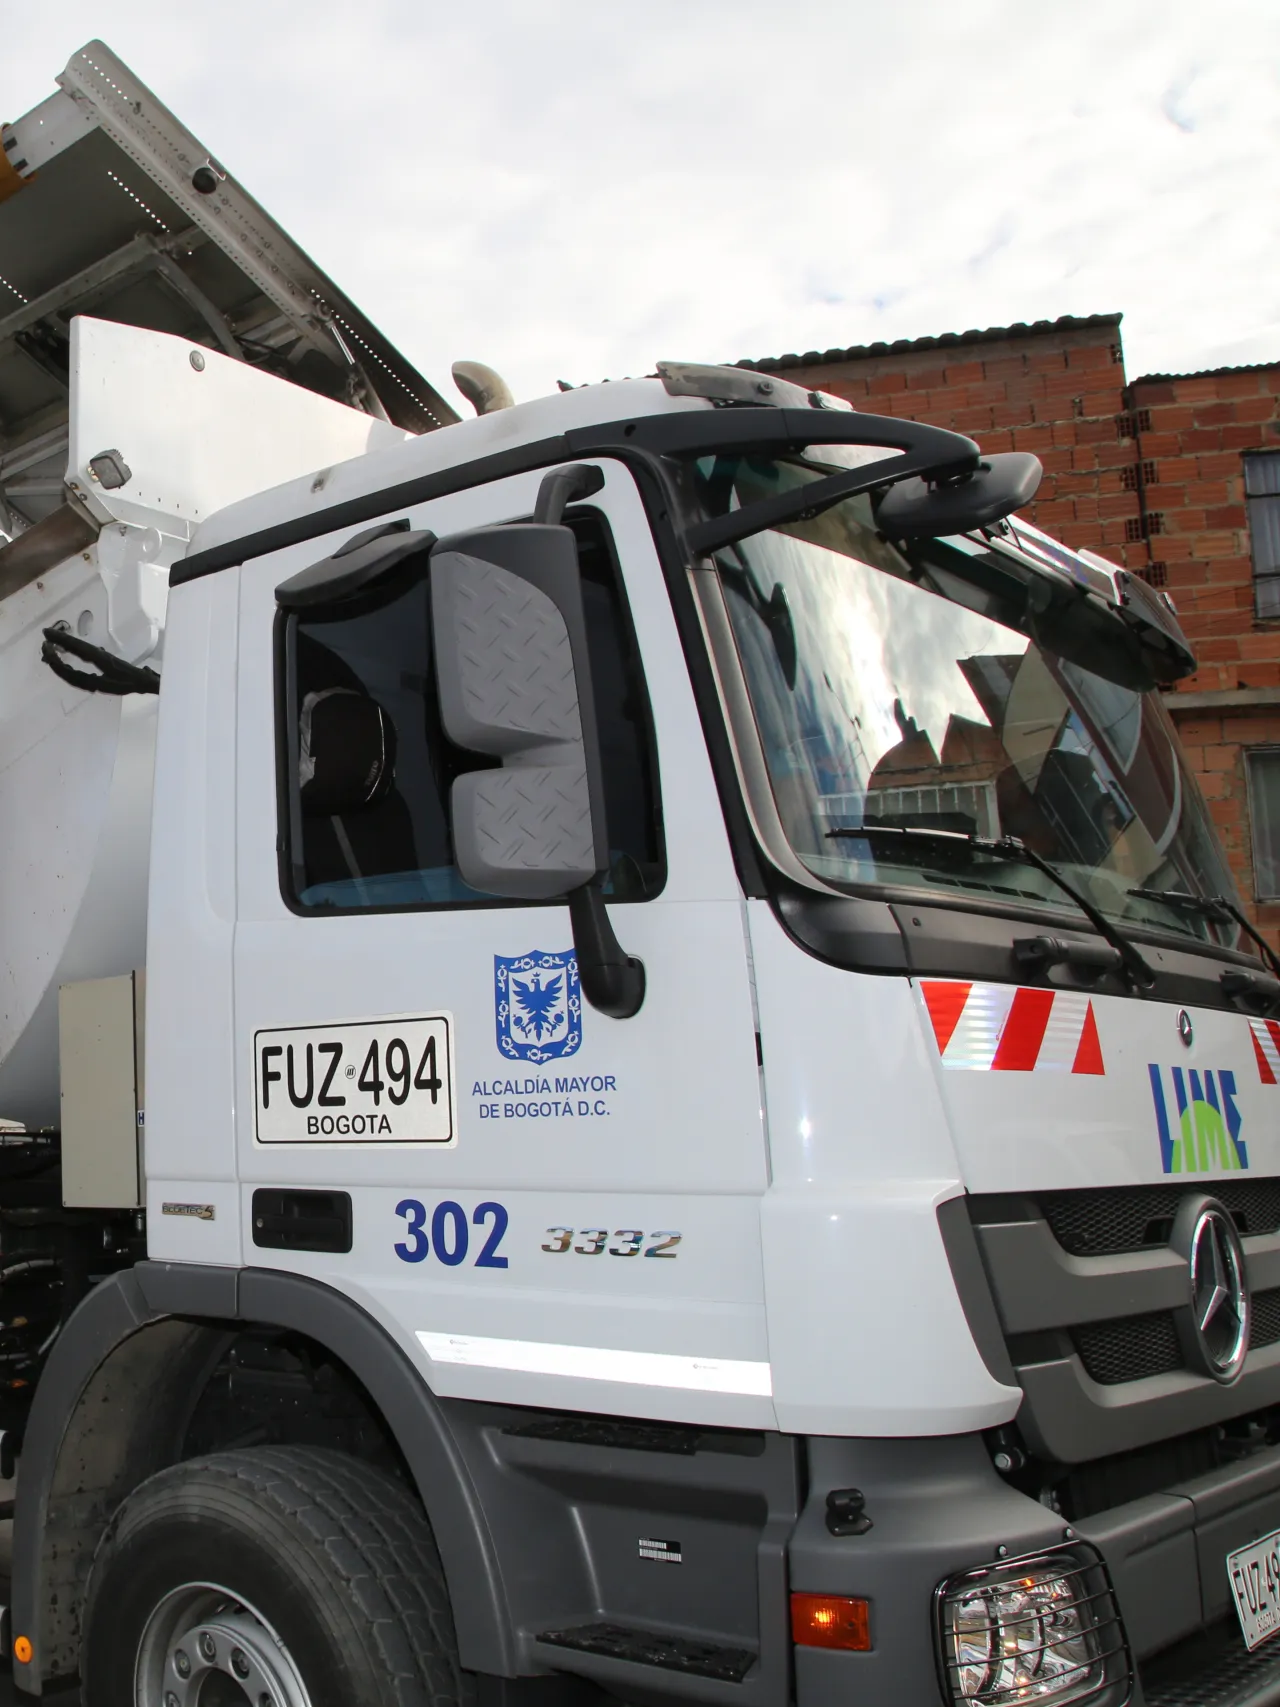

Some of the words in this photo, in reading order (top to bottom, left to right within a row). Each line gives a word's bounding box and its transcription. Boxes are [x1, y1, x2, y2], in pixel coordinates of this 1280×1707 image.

[262, 1042, 346, 1110] FUZ
[357, 1035, 443, 1106] 494
[472, 1074, 552, 1096] ALCALDÍA
[555, 1075, 617, 1094] MAYOR
[479, 1103, 500, 1119] DE
[504, 1097, 574, 1118] BOGOTÁ
[578, 1100, 610, 1116] D.C.
[307, 1114, 392, 1135] BOGOTA
[1147, 1063, 1249, 1174] LIME
[394, 1198, 509, 1269] 302
[540, 1225, 683, 1259] 3332
[1231, 1560, 1267, 1622] FUZ
[1264, 1551, 1280, 1603] 49
